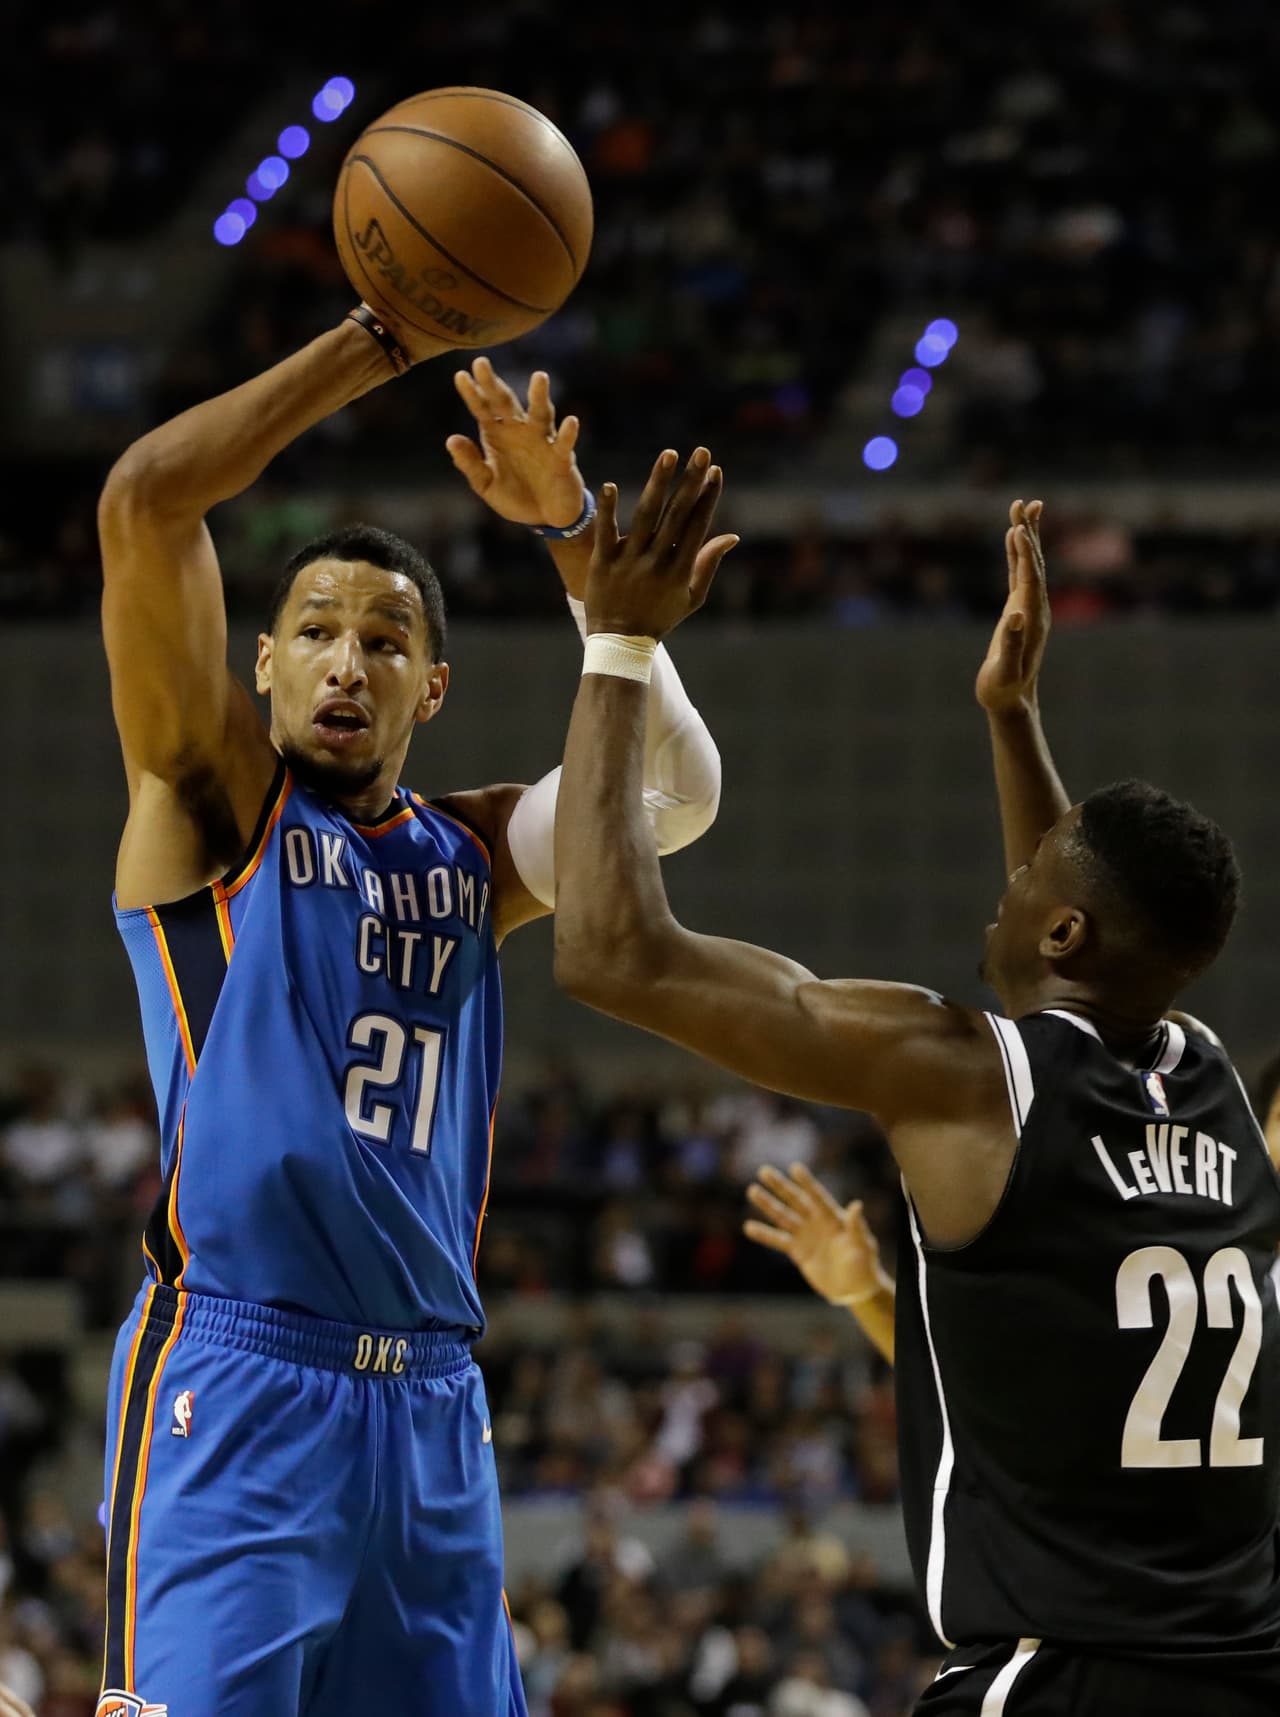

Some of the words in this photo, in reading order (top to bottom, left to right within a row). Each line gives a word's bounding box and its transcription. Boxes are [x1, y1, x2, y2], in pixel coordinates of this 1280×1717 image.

[284, 828, 489, 938] OKAHOMA
[343, 1013, 444, 1153] 21
[354, 1334, 408, 1375] OKC
[1115, 1245, 1265, 1469] 22
